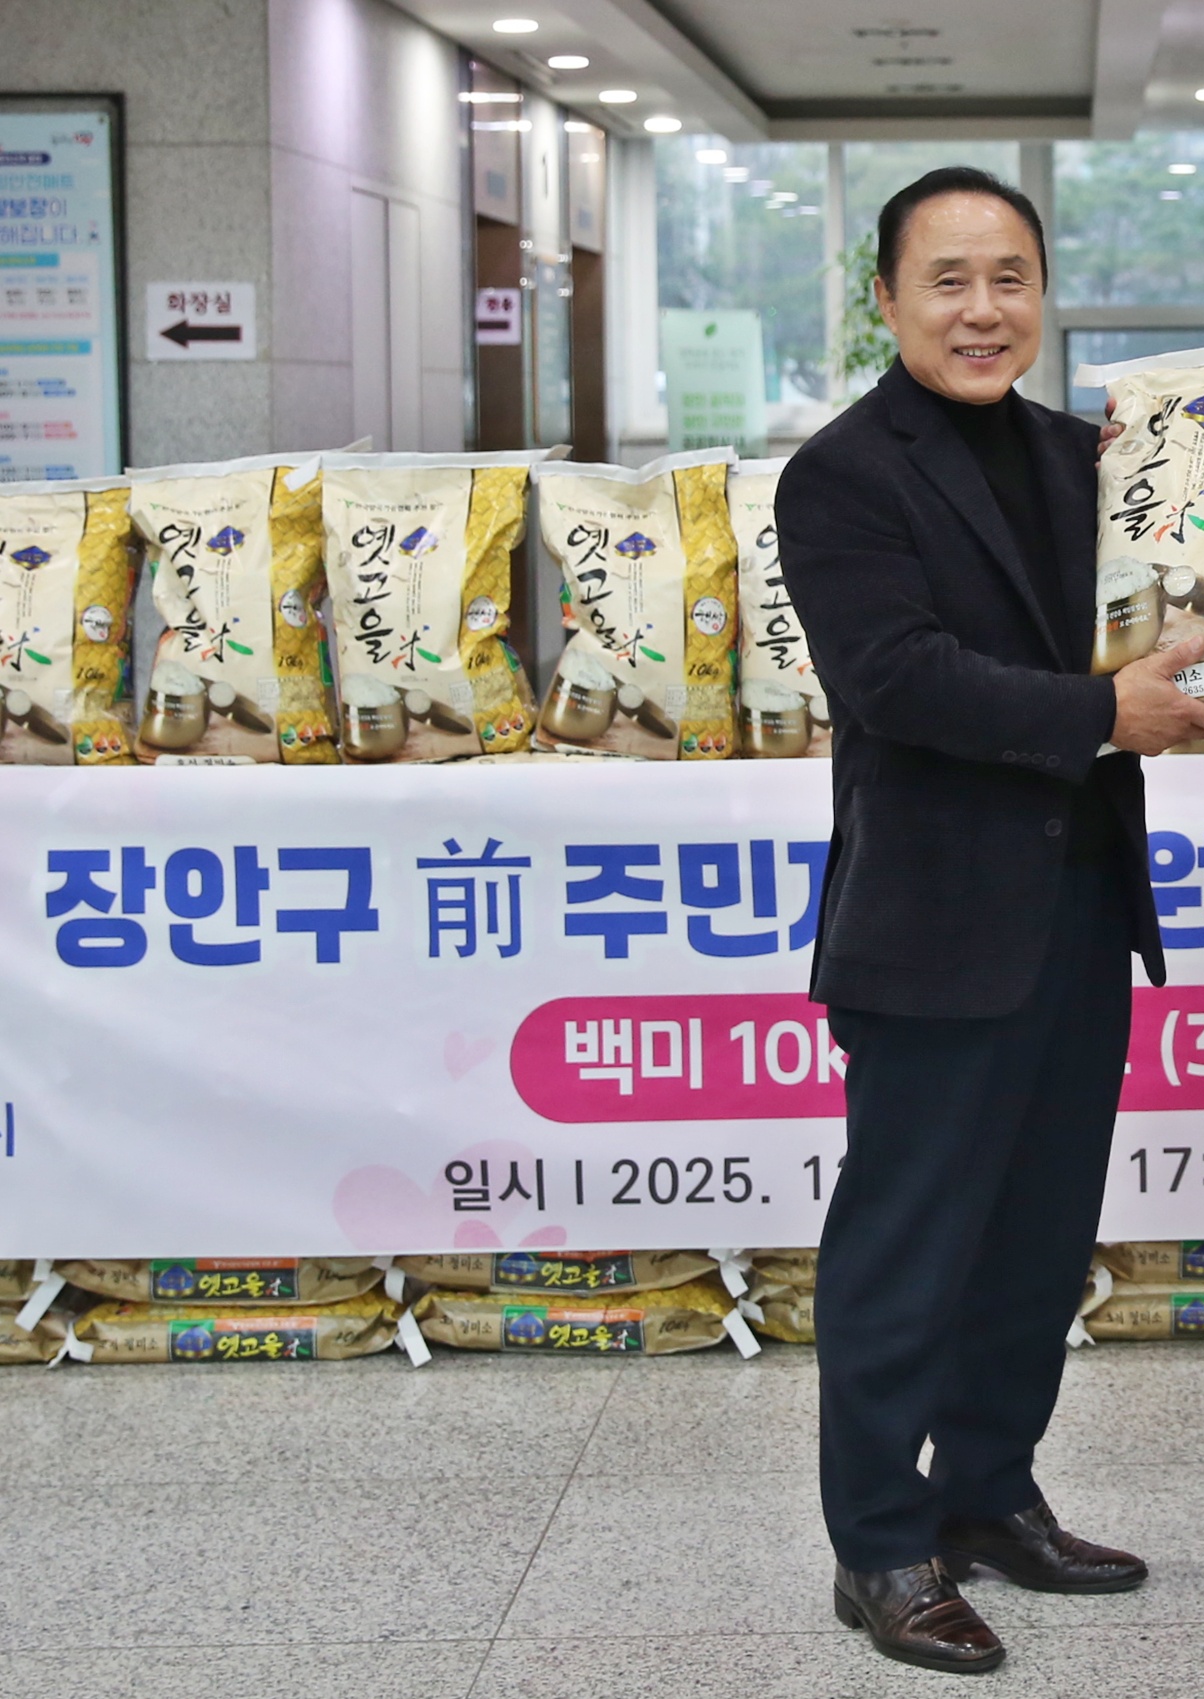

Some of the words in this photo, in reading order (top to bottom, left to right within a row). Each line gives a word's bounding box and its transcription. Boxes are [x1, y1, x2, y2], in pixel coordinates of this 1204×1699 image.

[166, 291, 234, 316] 화장실
[352, 524, 396, 665] 옛고을
[567, 524, 615, 652] 옛고을
[45, 846, 380, 968] 장안구
[416, 837, 532, 959] 前
[564, 1017, 704, 1096] 백미
[443, 1157, 546, 1213] 일시
[609, 1154, 773, 1207] 2025.
[199, 1272, 266, 1298] 옛고을
[540, 1261, 602, 1289] 옛고을
[216, 1331, 285, 1360] 옛고을
[549, 1322, 614, 1352] 옛고을
